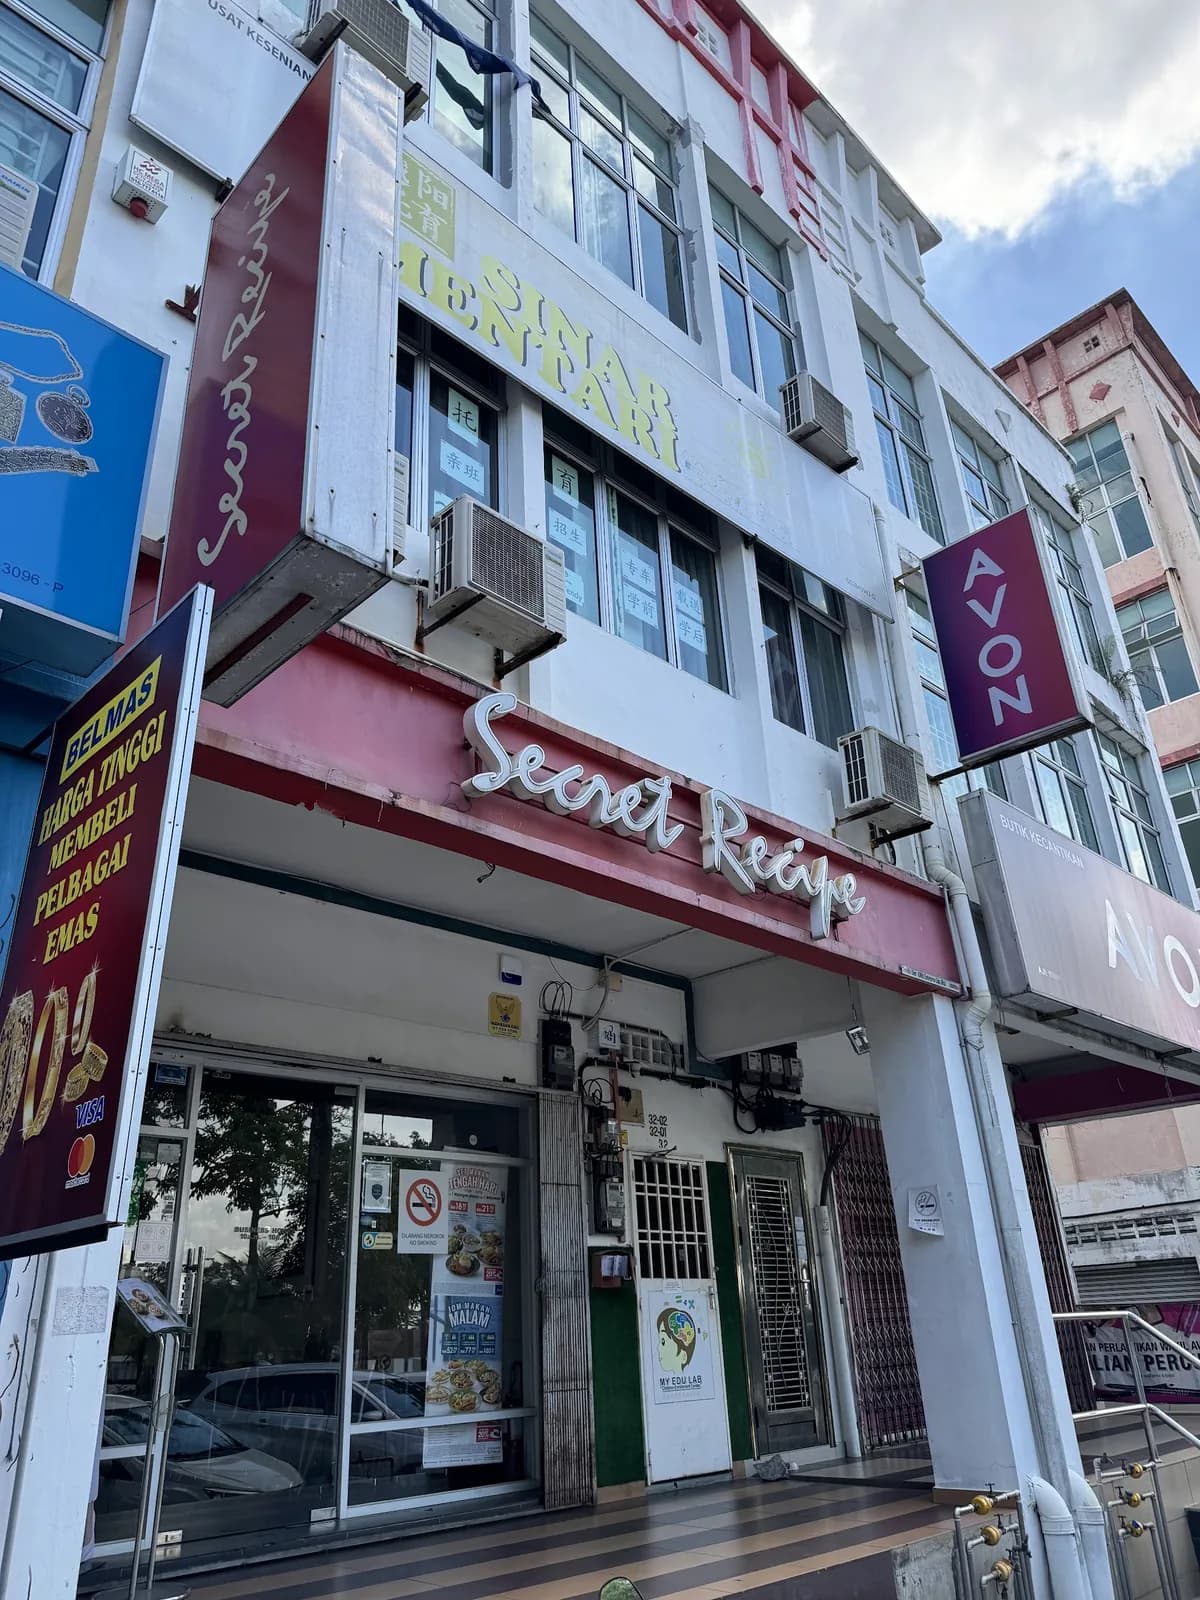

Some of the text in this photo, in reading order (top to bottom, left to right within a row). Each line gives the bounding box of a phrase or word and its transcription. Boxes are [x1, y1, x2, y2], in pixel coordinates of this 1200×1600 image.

[246, 26, 312, 82] KESENIAN
[197, 172, 290, 567] Secret Recipe
[479, 255, 678, 433] SINAR
[452, 402, 477, 433] 托
[556, 468, 576, 496] 育
[553, 517, 584, 545] 招生
[963, 547, 1033, 727] AVON
[66, 671, 154, 771] BELMAS
[38, 709, 167, 847] HARGA TINGGI
[47, 783, 138, 876] MEMBELI
[461, 691, 867, 941] Secret Recipe
[1000, 814, 1085, 869] BUTIK KECANTIKAN
[33, 833, 132, 927] PELBAGAI
[42, 902, 100, 965] EMAS
[1105, 898, 1200, 1008] AVO
[76, 1095, 105, 1129] VISA
[648, 1114, 668, 1126] 32-02
[649, 1126, 667, 1137] 32-01
[449, 1174, 498, 1194] TENGAH HARI
[449, 1309, 490, 1328] MALAM
[659, 1374, 703, 1386] MY EDU LAB
